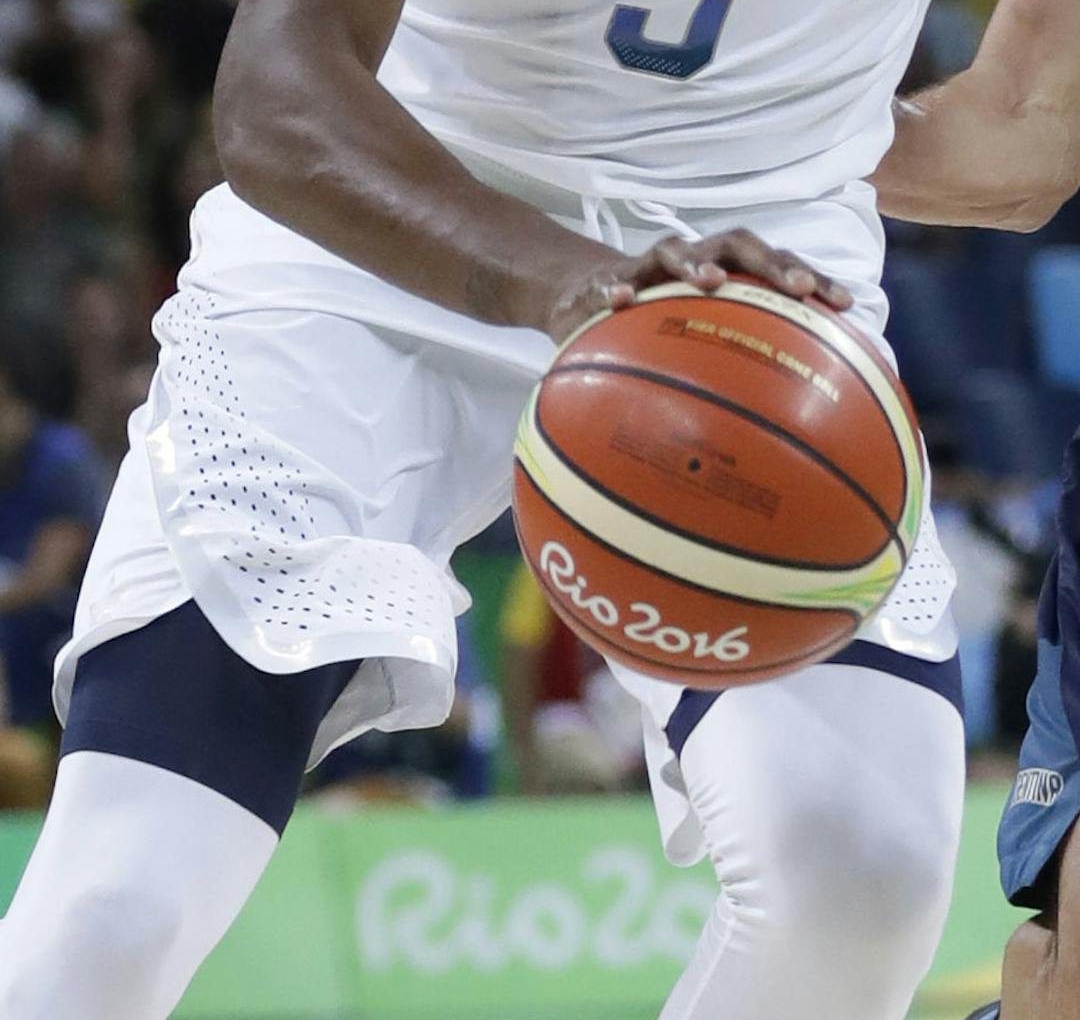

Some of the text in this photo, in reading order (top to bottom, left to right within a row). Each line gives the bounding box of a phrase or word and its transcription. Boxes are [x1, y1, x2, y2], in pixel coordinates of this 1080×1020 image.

[540, 541, 750, 661] Rio 2016
[356, 845, 718, 974] Rio 20
